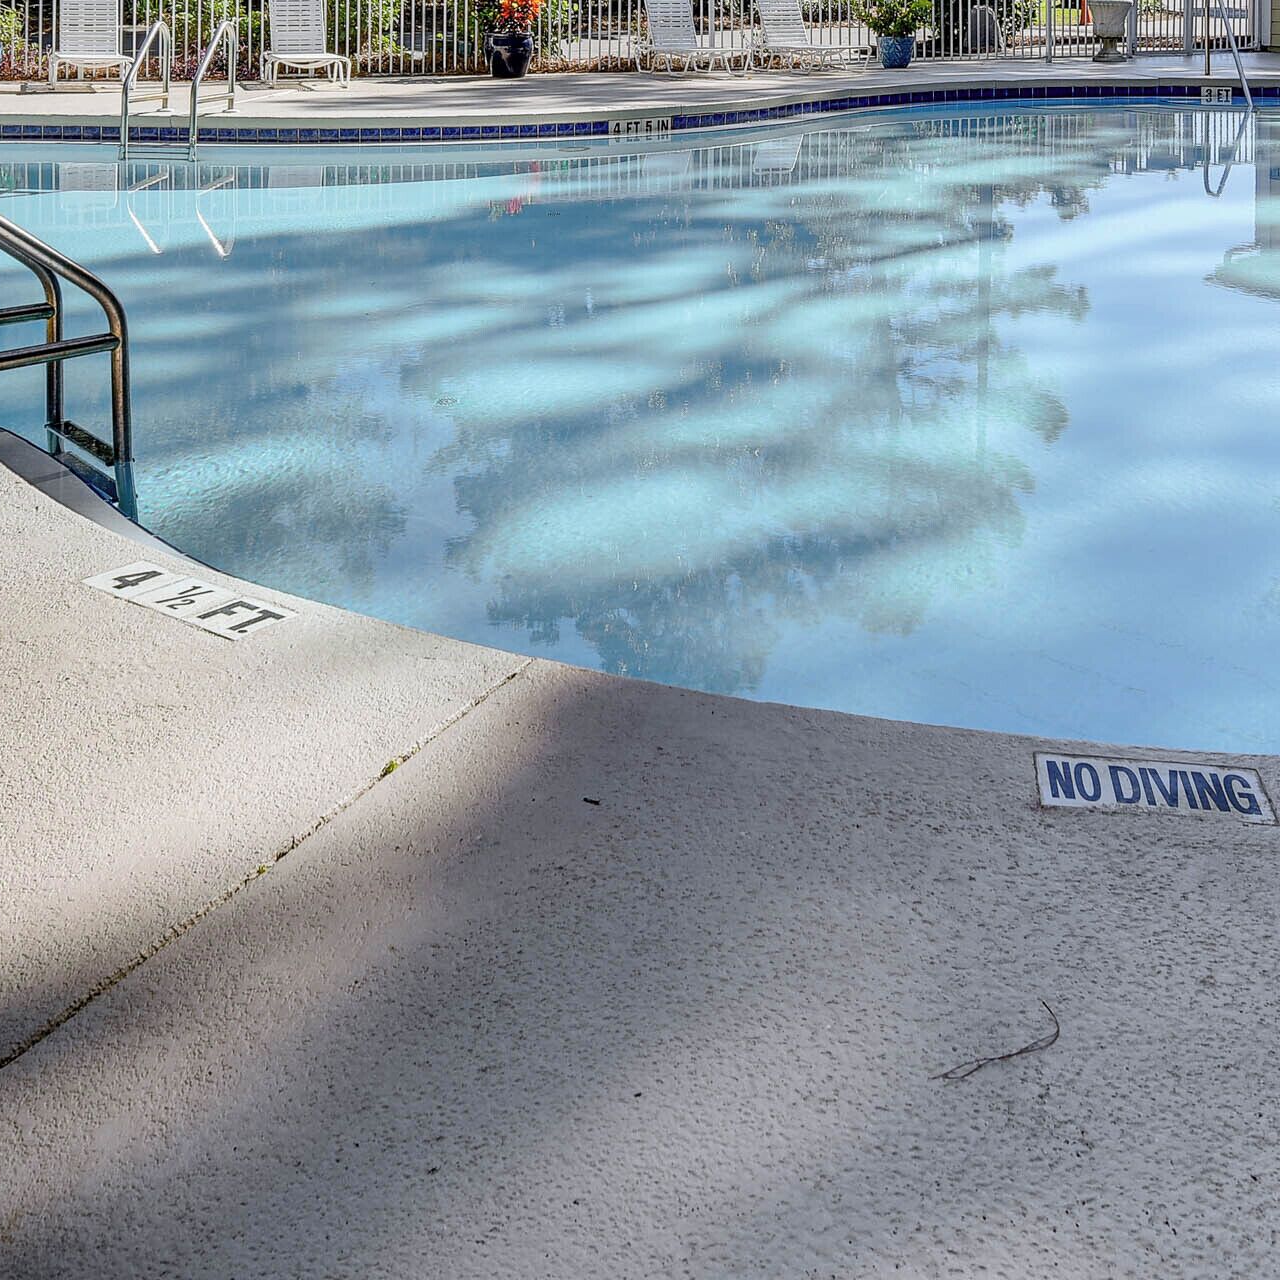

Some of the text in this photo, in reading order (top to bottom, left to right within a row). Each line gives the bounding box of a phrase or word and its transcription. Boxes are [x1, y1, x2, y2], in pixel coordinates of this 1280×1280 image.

[1206, 89, 1212, 102] 3
[613, 119, 669, 133] 4 FT 5 IN
[112, 570, 163, 590] 4
[1045, 760, 1263, 816] NO DIVING
